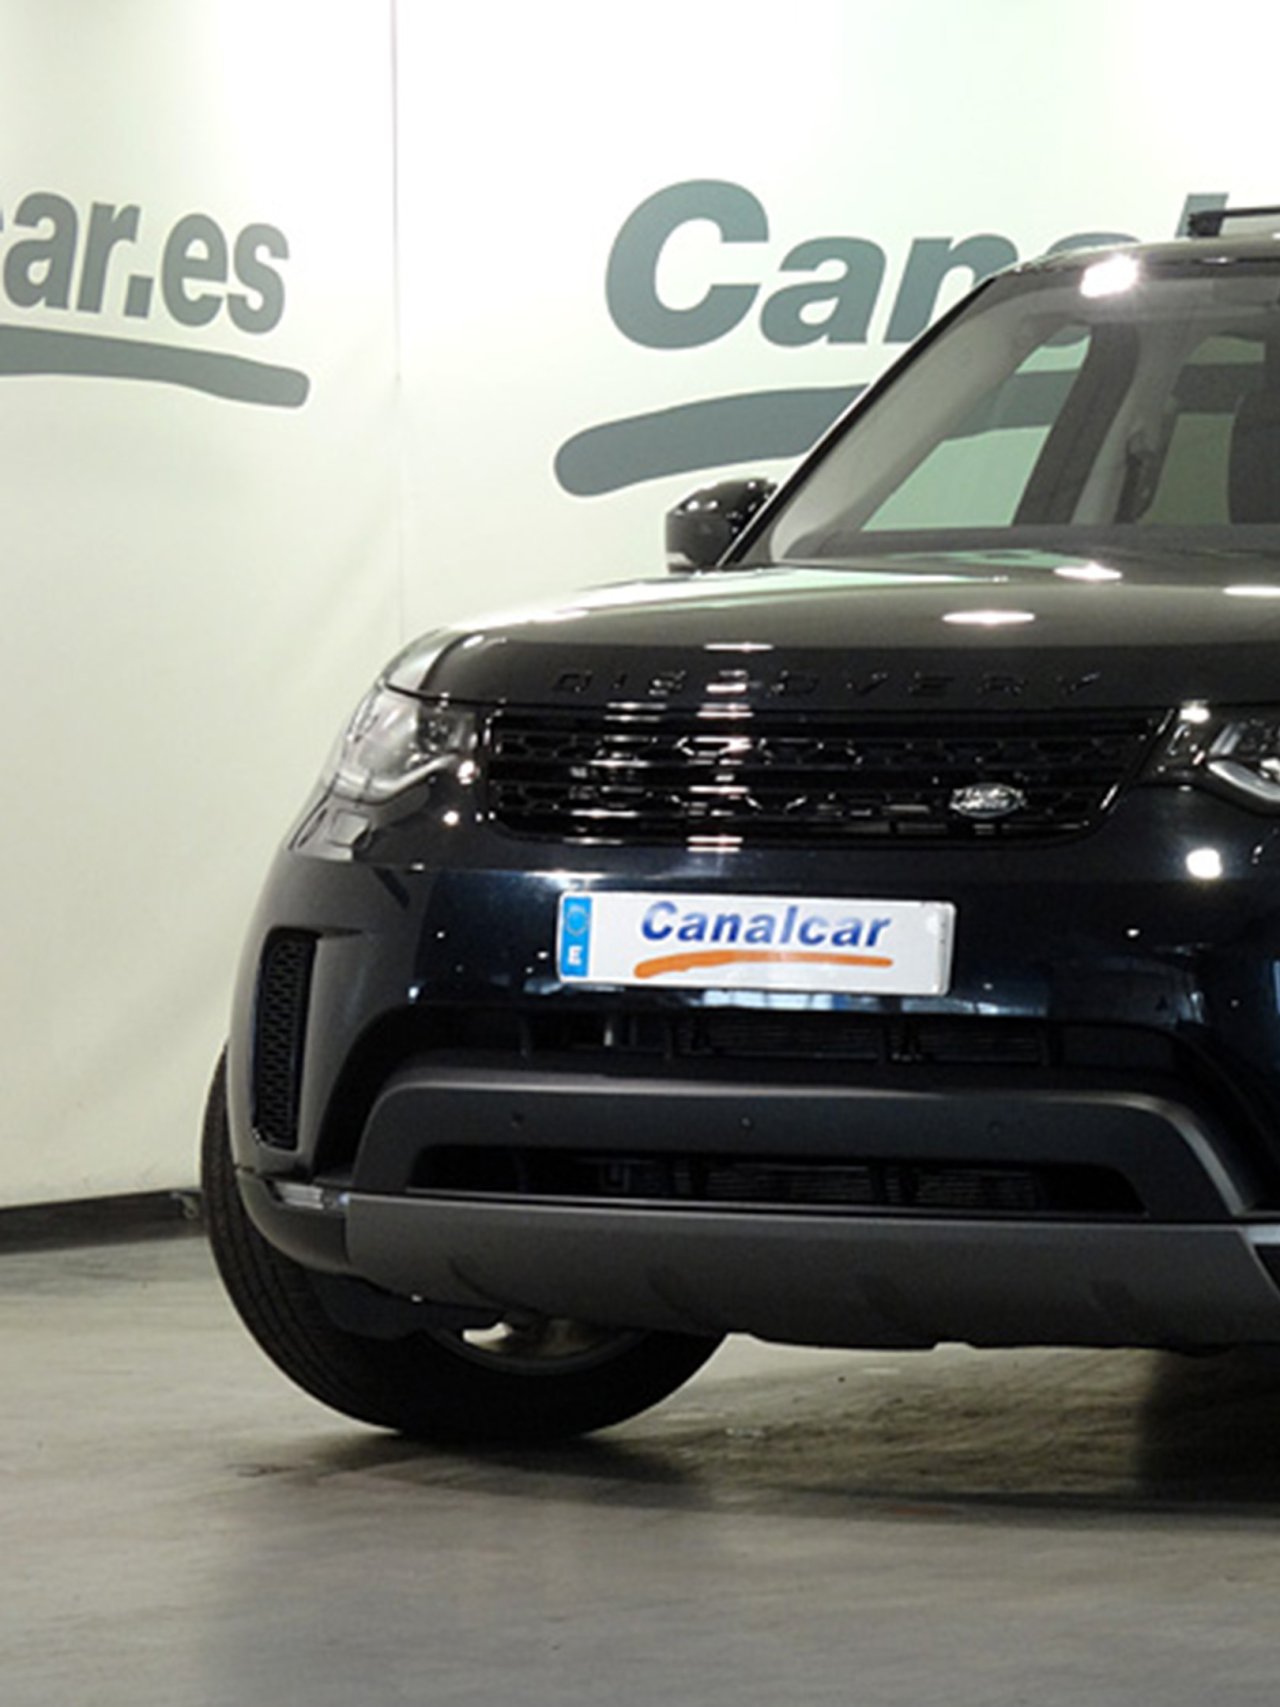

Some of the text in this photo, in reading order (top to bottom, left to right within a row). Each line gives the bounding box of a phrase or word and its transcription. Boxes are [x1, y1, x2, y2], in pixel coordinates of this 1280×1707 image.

[0, 191, 290, 334] ar.es
[604, 178, 1229, 350] Can
[567, 945, 583, 966] E
[641, 901, 891, 947] Canalcar
